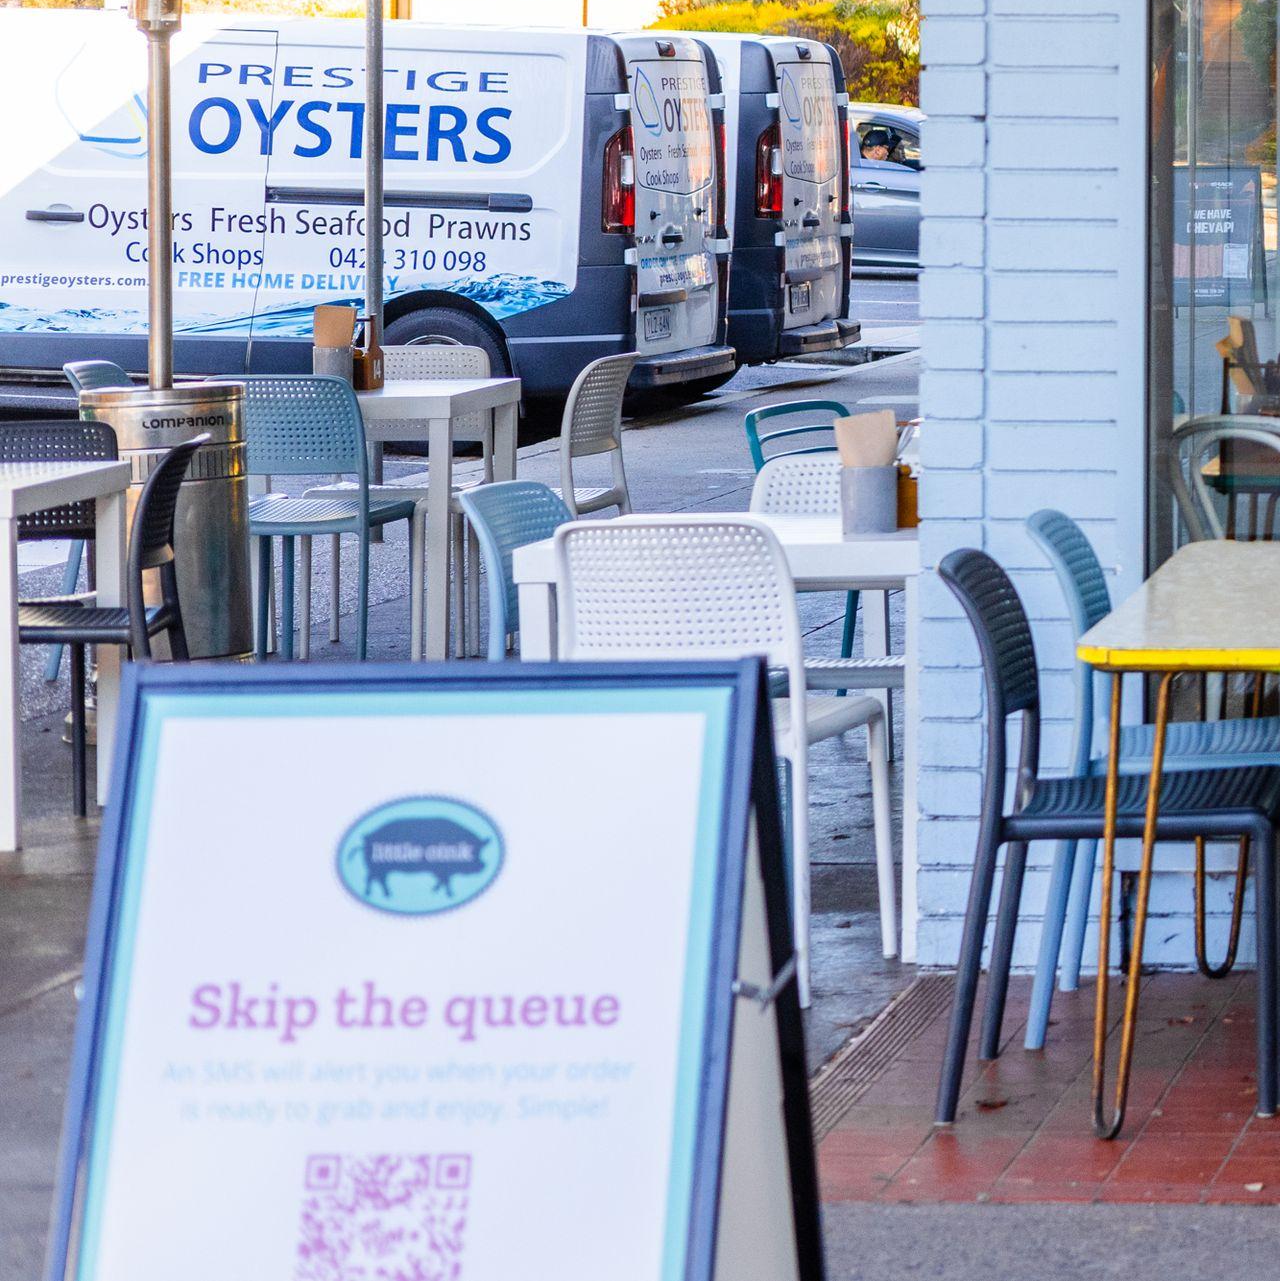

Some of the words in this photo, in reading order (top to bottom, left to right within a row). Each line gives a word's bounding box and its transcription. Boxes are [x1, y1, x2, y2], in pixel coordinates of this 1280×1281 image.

[188, 96, 513, 164] OYSTERS
[88, 203, 193, 236] Oystrs
[211, 207, 286, 234] Fresh
[429, 213, 531, 241] Prawns
[1207, 209, 1232, 219] HAVE
[192, 242, 263, 270] Shops
[393, 249, 436, 270] 310
[443, 251, 486, 271] 098
[178, 272, 225, 288] FREE
[232, 273, 294, 289] HOME
[302, 274, 399, 291] DELIVY
[188, 982, 319, 1043] Skip
[335, 982, 428, 1029] the
[443, 993, 621, 1042] queue
[262, 1060, 302, 1082] will
[310, 1060, 367, 1082] alert
[374, 1066, 420, 1088] you
[426, 1060, 493, 1082] when
[500, 1065, 557, 1087] your
[564, 1058, 635, 1081] order
[206, 1100, 278, 1125] ready
[284, 1100, 310, 1120] to
[316, 1096, 373, 1125] grab
[380, 1097, 430, 1120] and
